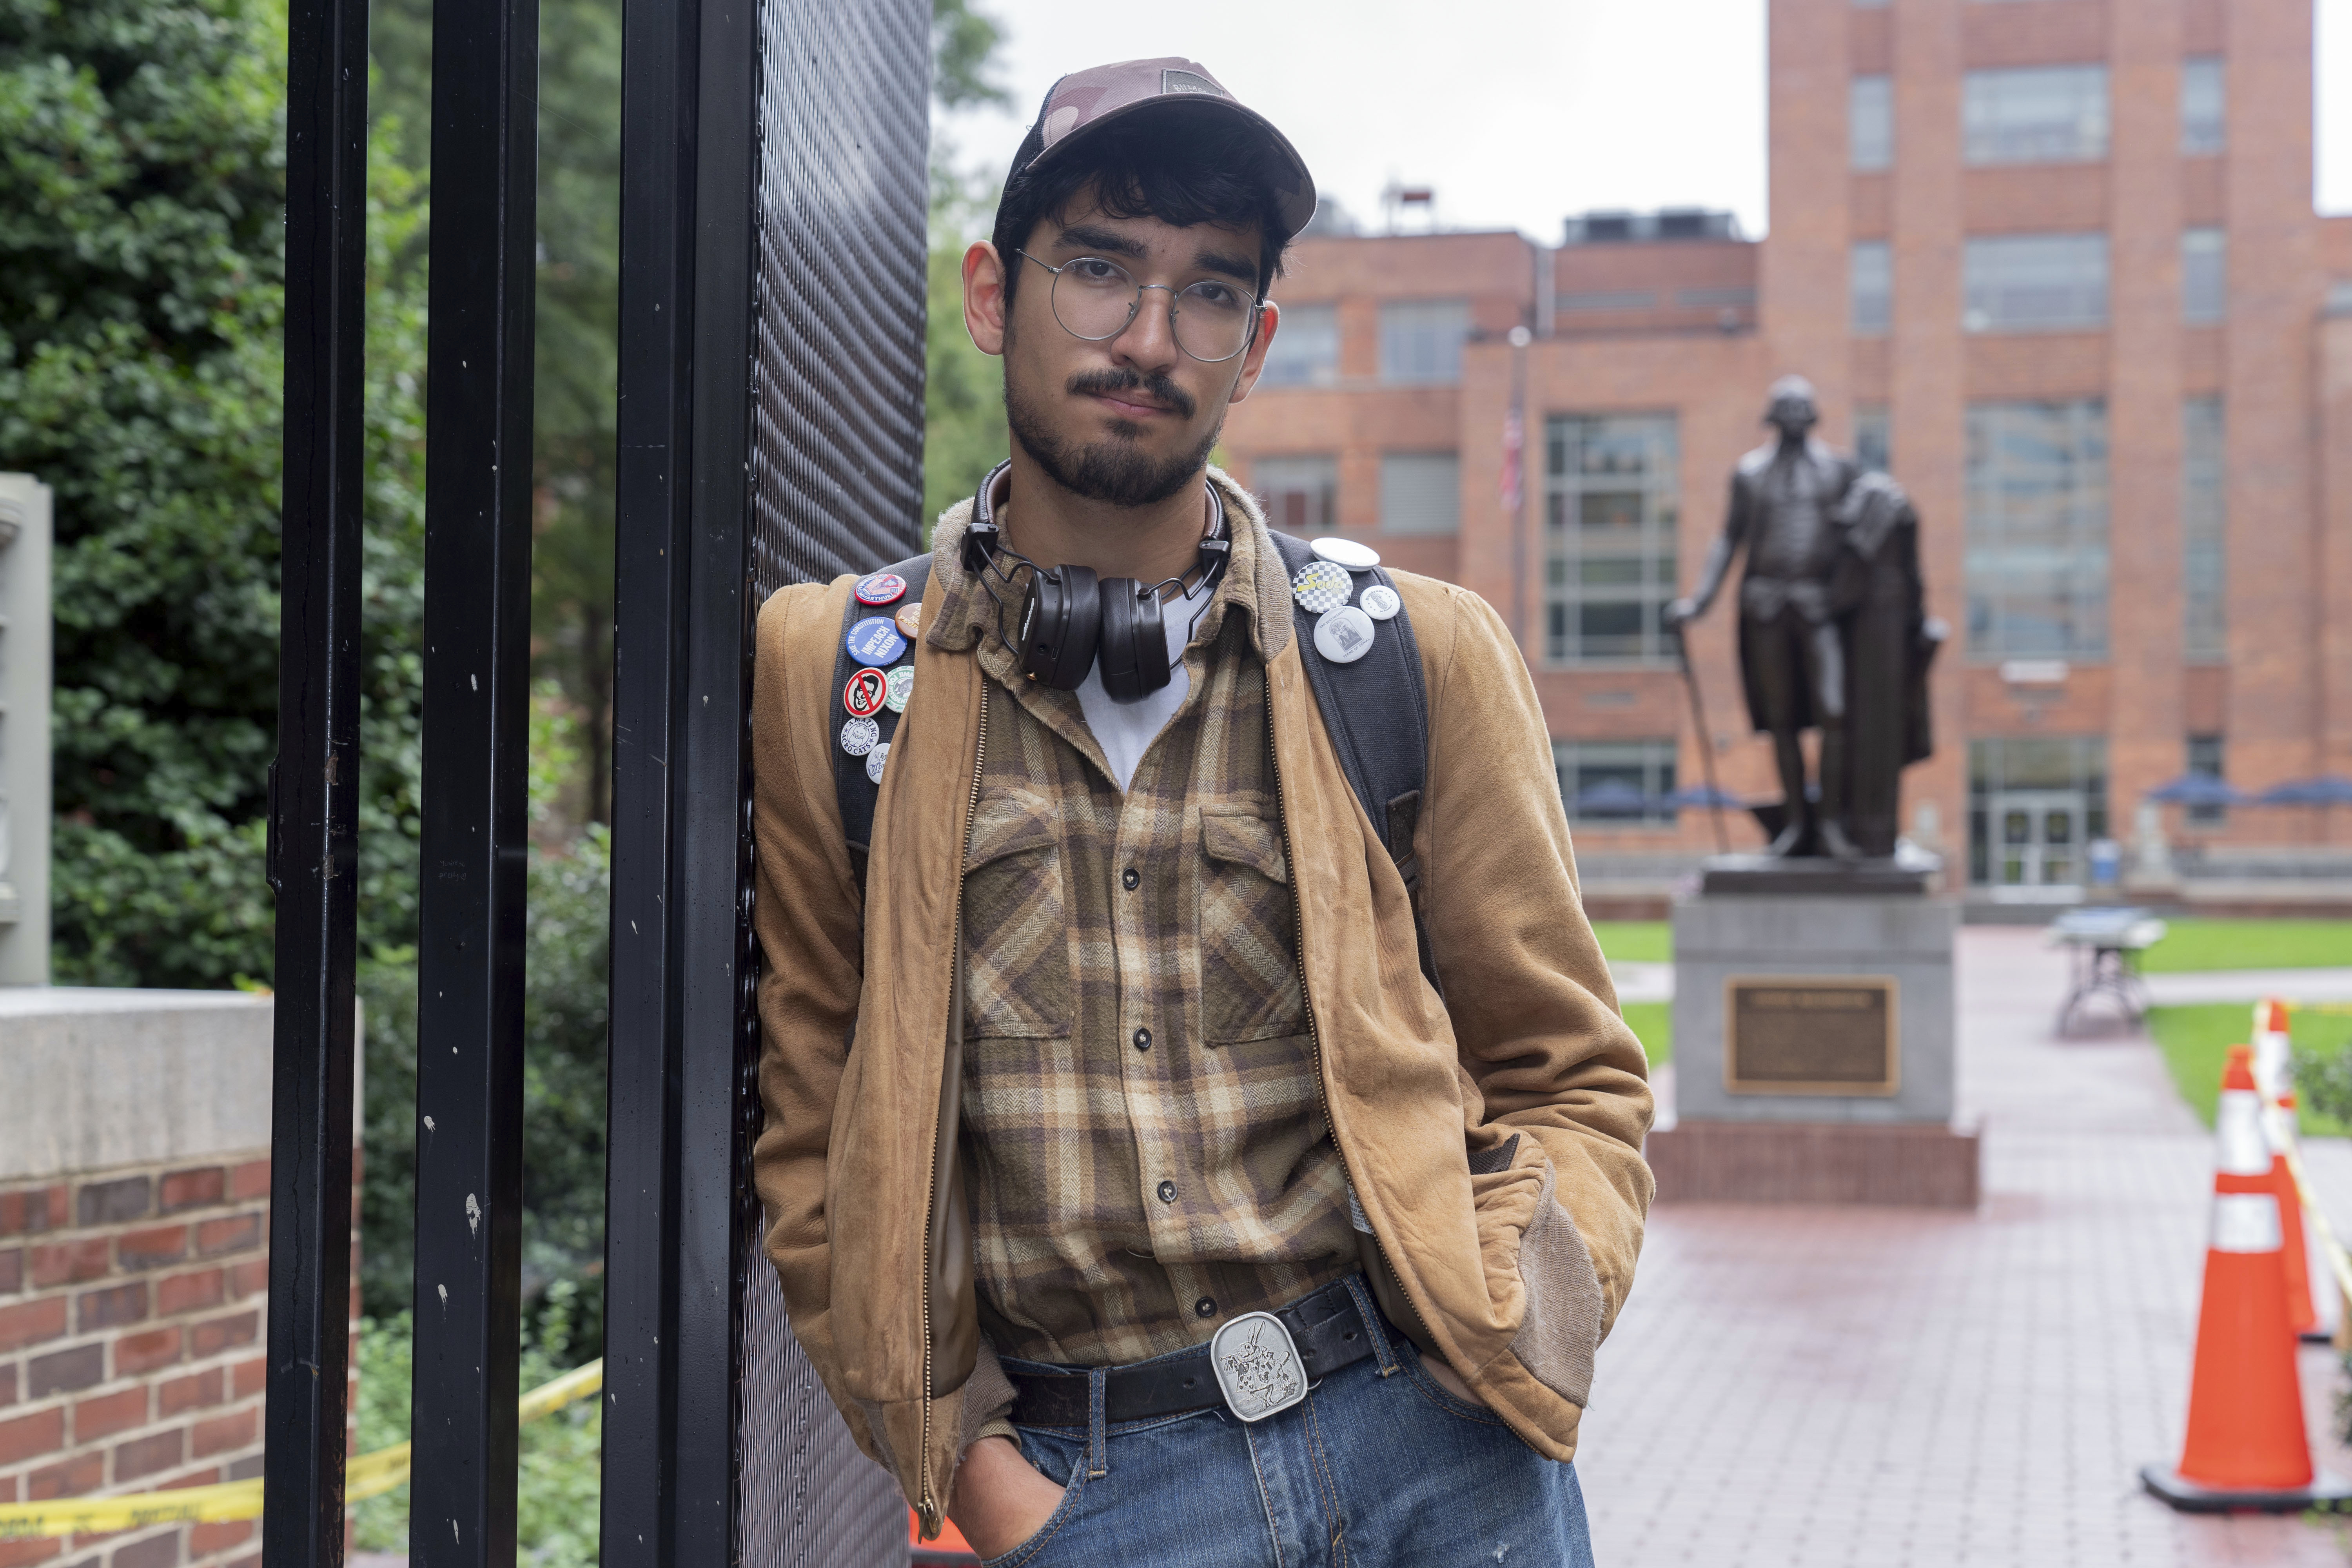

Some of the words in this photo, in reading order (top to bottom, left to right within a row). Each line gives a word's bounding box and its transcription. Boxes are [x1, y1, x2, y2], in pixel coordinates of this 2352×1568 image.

[1297, 573, 1344, 592] Soda
[851, 618, 885, 635] CONSTITUTION
[897, 614, 918, 631] PEOP
[861, 625, 891, 655] IMPEACH
[874, 633, 899, 659] NIXON
[1343, 649, 1354, 658] TEENS
[1359, 638, 1371, 647] DENIAL
[849, 644, 860, 656] SAVE
[889, 675, 899, 686] FOR
[848, 718, 877, 737] AMAZING
[842, 733, 852, 752] ACRO
[853, 742, 871, 755] CATS
[869, 762, 881, 776] ROCK
[438, 871, 459, 882] pretty
